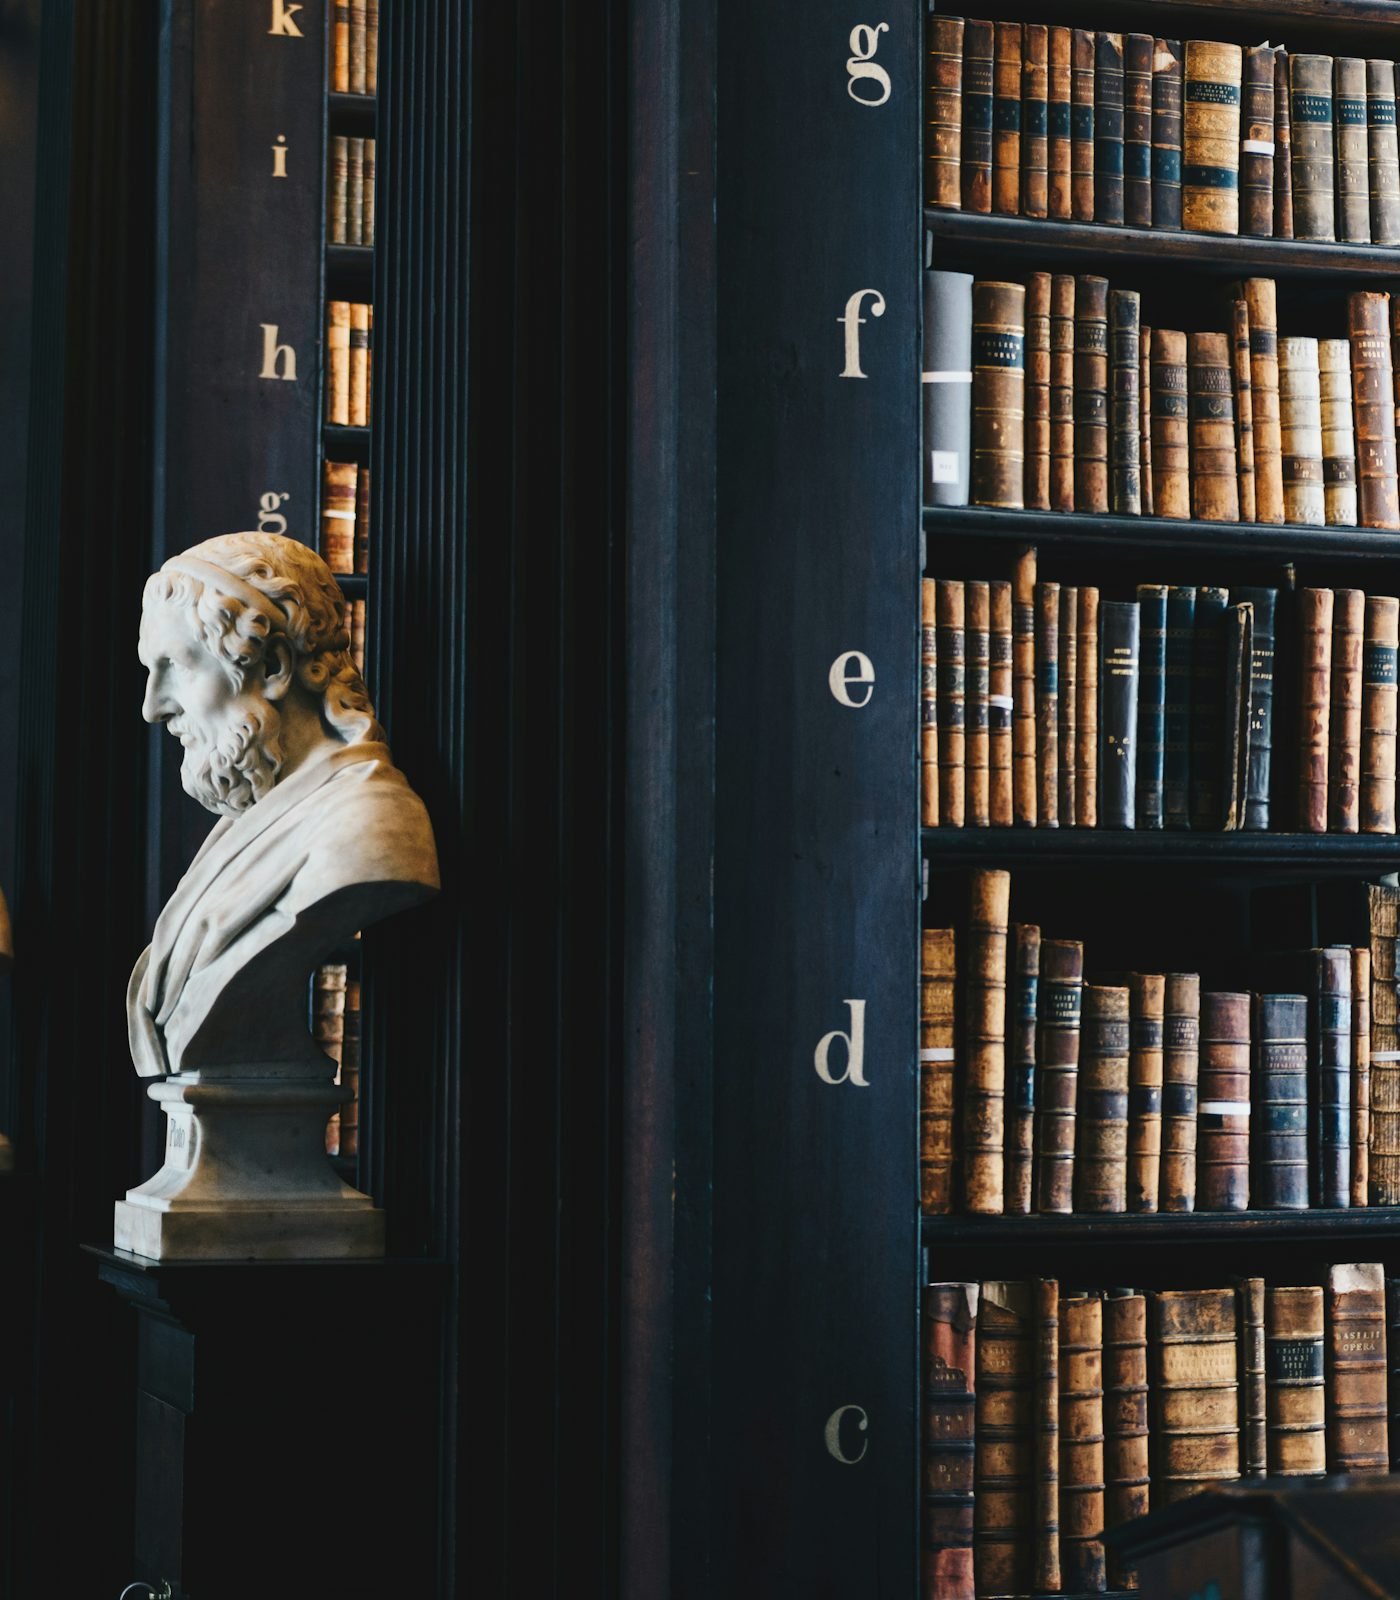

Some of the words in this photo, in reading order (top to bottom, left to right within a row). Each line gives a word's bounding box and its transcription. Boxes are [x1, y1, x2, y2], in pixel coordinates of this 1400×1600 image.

[267, 0, 305, 38] k
[846, 22, 892, 107] g
[272, 134, 289, 178] i
[259, 323, 297, 381] h
[837, 288, 886, 379] f
[257, 491, 291, 535] g
[828, 651, 876, 708] e
[813, 998, 870, 1087] d
[1342, 1343, 1377, 1352] OPERA
[824, 1404, 869, 1465] c
